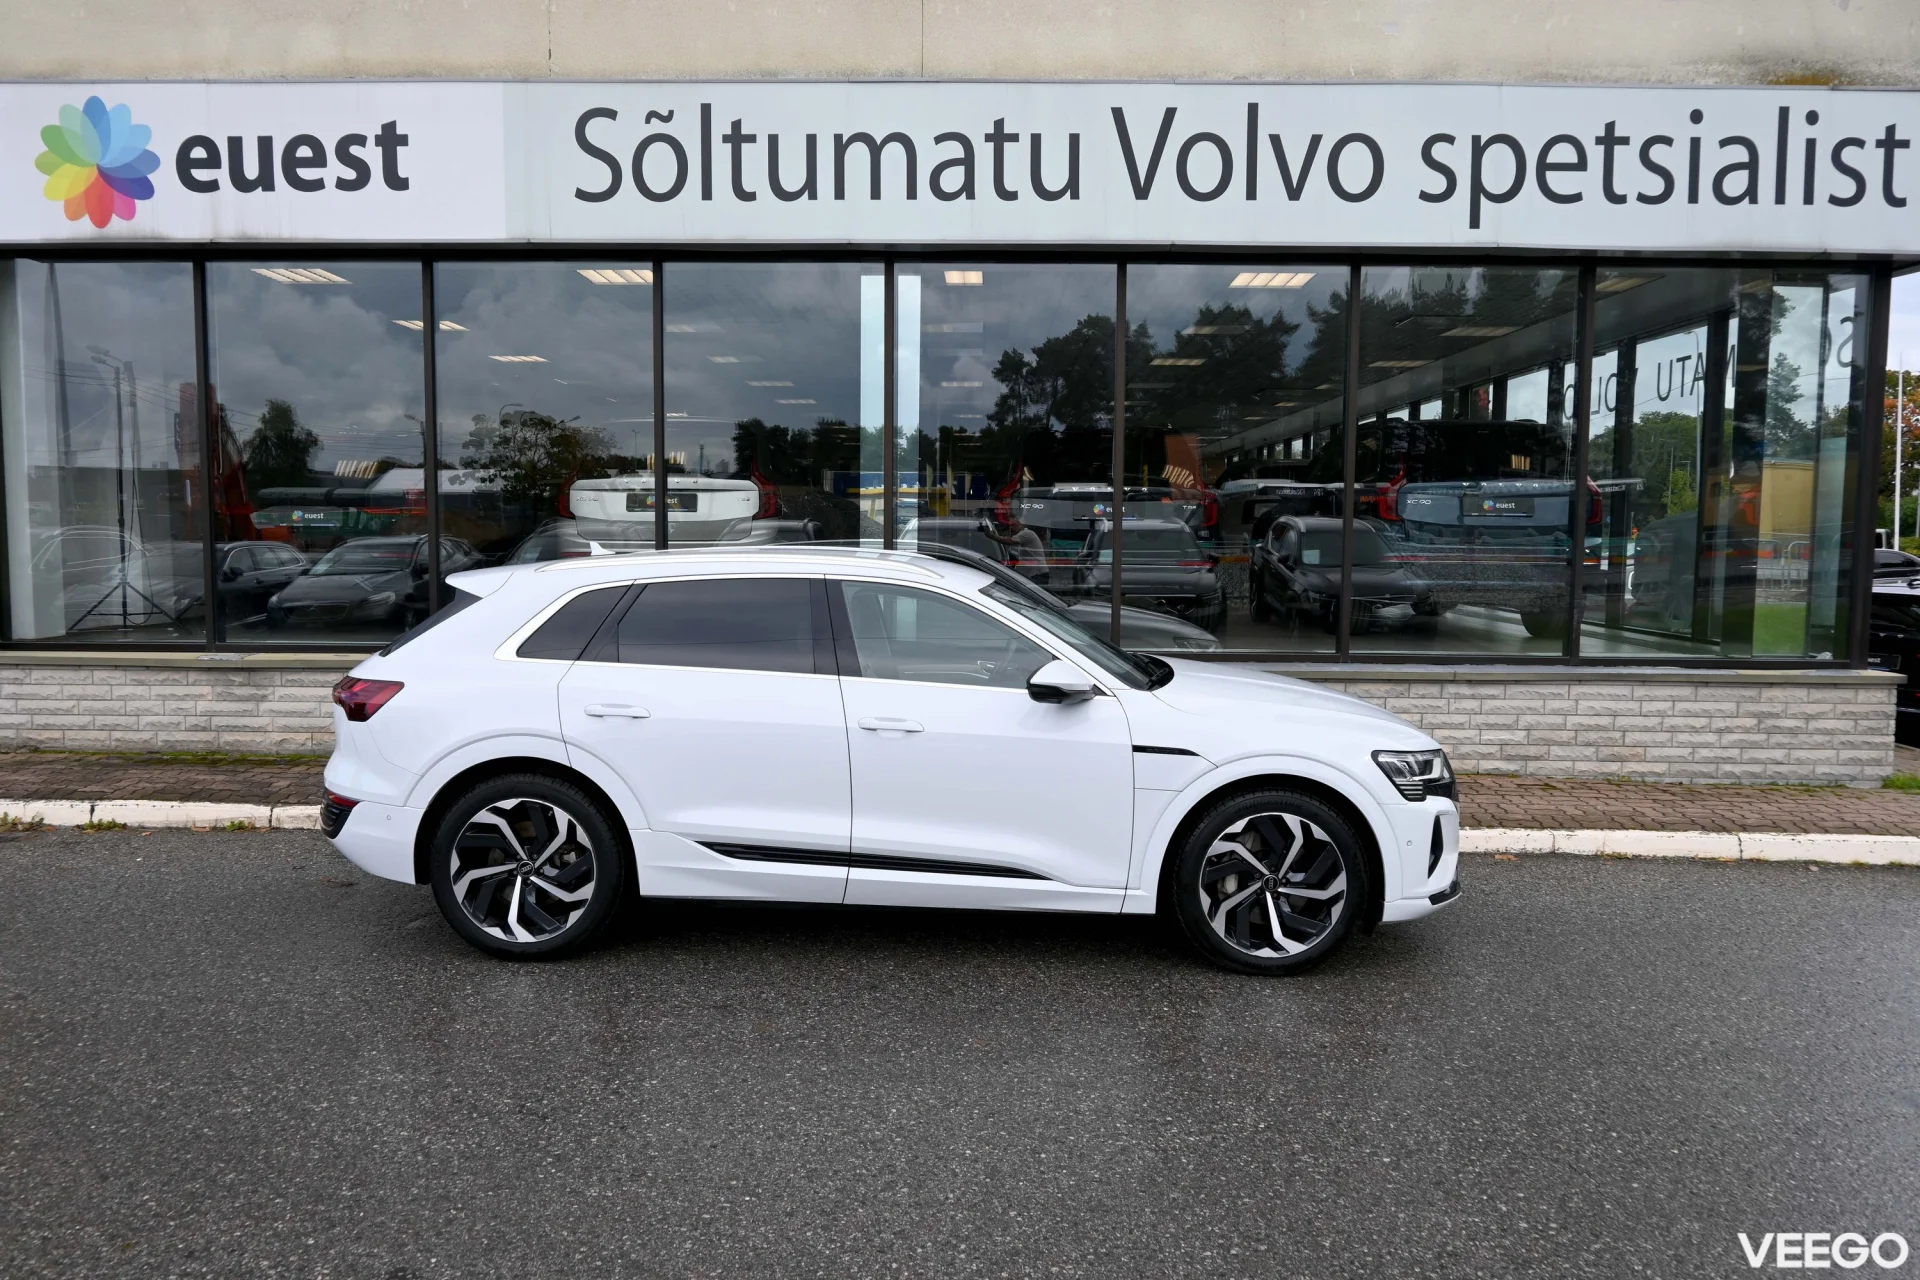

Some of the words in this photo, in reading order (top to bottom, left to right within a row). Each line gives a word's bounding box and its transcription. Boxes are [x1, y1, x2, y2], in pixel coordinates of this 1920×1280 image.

[175, 119, 410, 193] euest
[574, 102, 1081, 203] Sõltumatu
[1110, 102, 1385, 203] Volvo
[1418, 105, 1911, 229] spetsialist
[1495, 501, 1516, 509] euest
